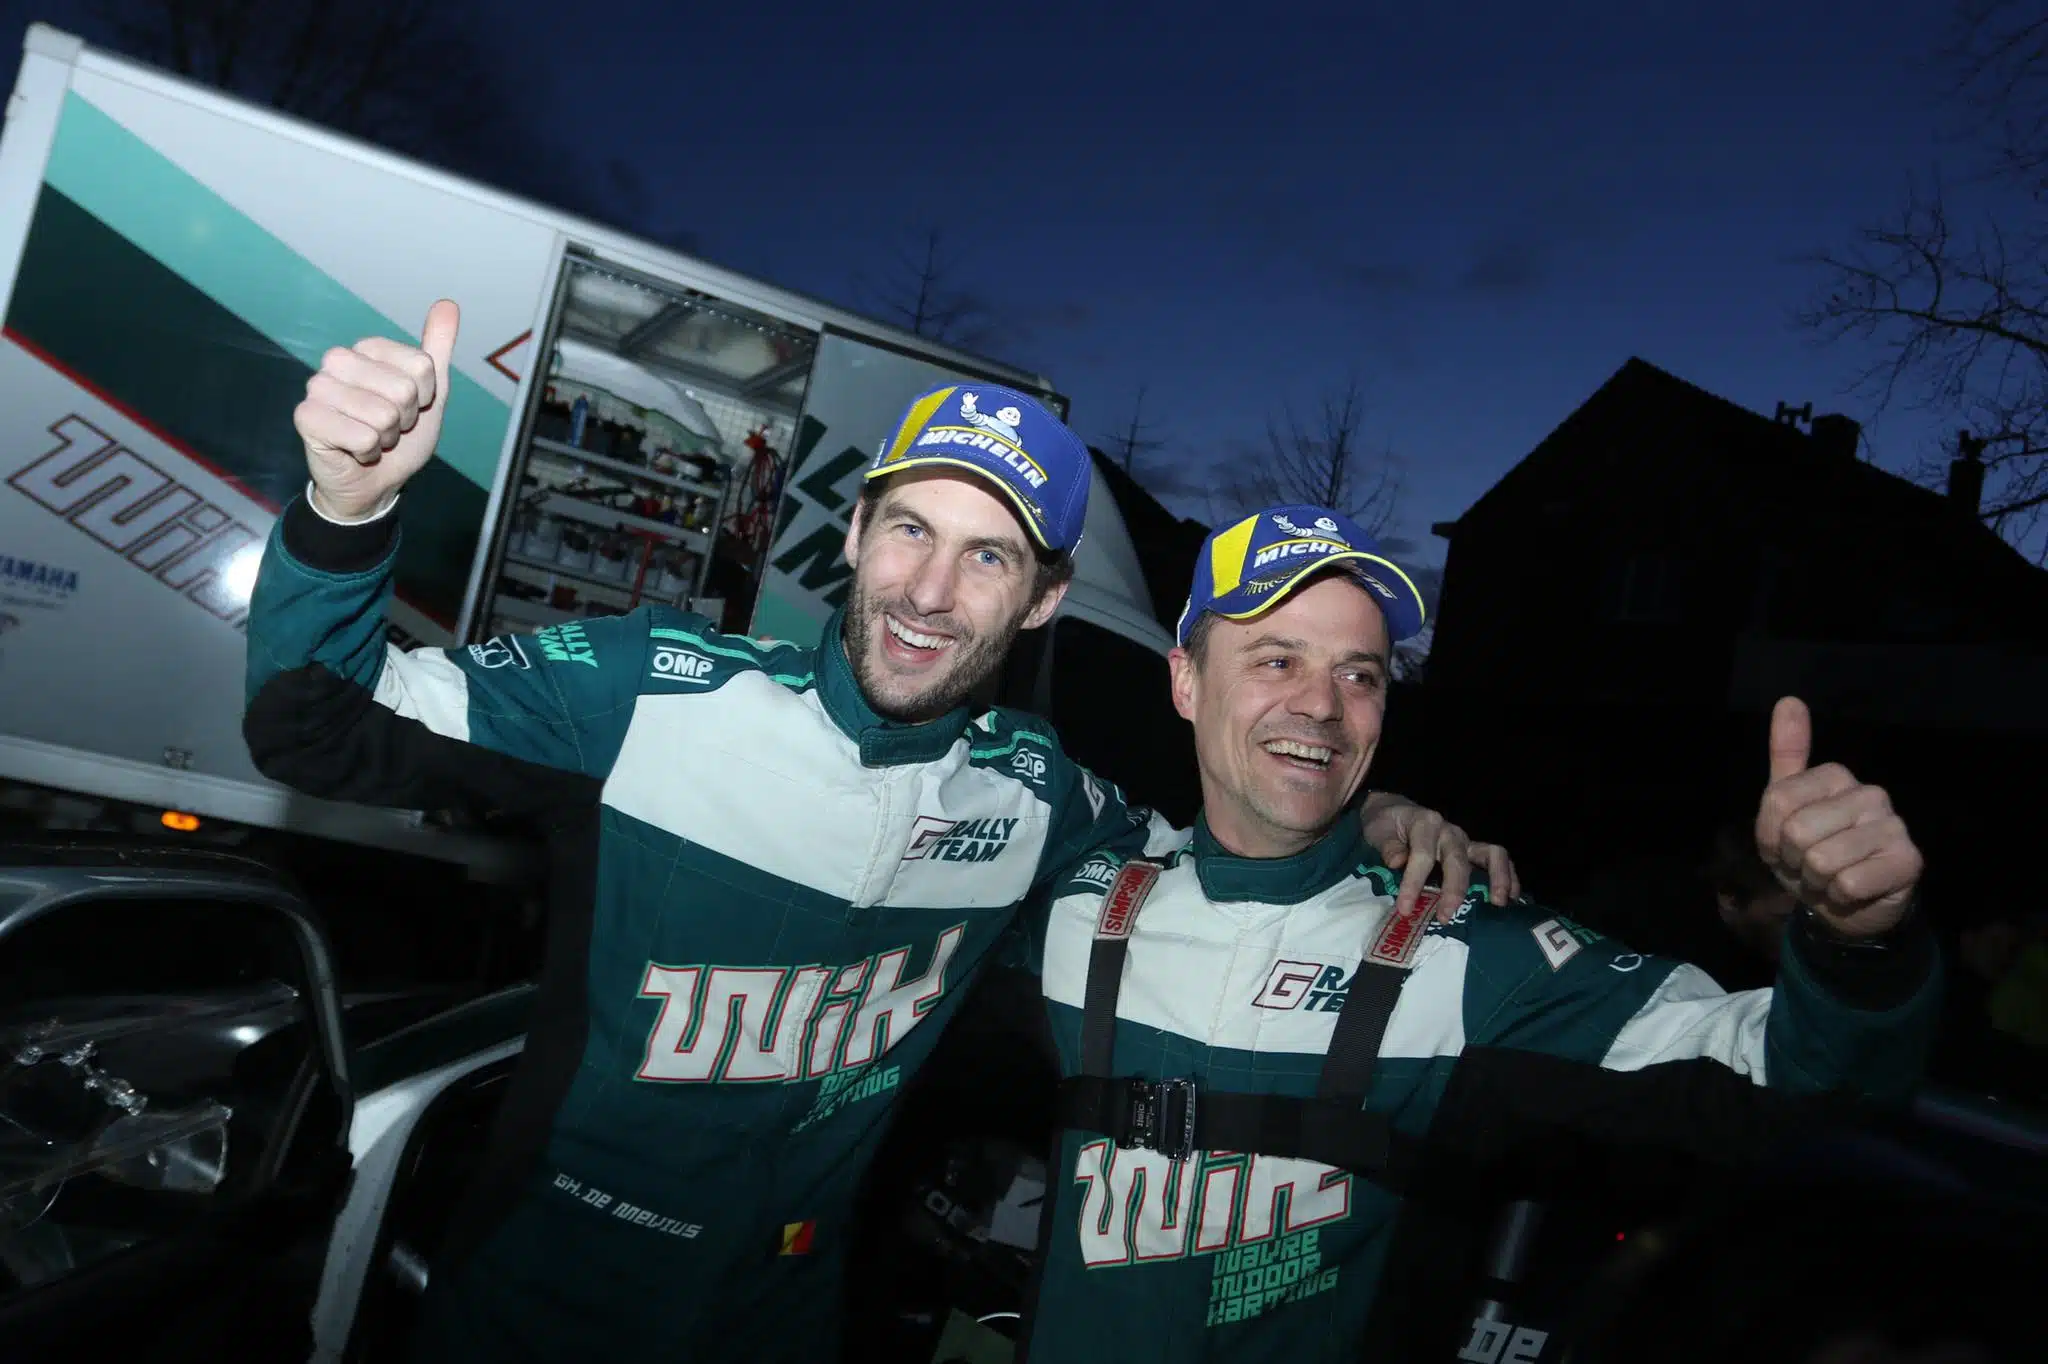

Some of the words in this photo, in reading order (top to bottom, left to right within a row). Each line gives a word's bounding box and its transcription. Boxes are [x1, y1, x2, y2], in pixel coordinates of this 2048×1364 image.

[917, 430, 1045, 489] MICHELIN
[1254, 541, 1347, 568] MICH
[0, 554, 77, 592] AMAHA
[652, 652, 714, 678] OMP
[944, 817, 1019, 841] RALLY
[930, 838, 1007, 863] TEAM
[1305, 989, 1350, 1012] TE
[1210, 1252, 1322, 1302] INDOOR
